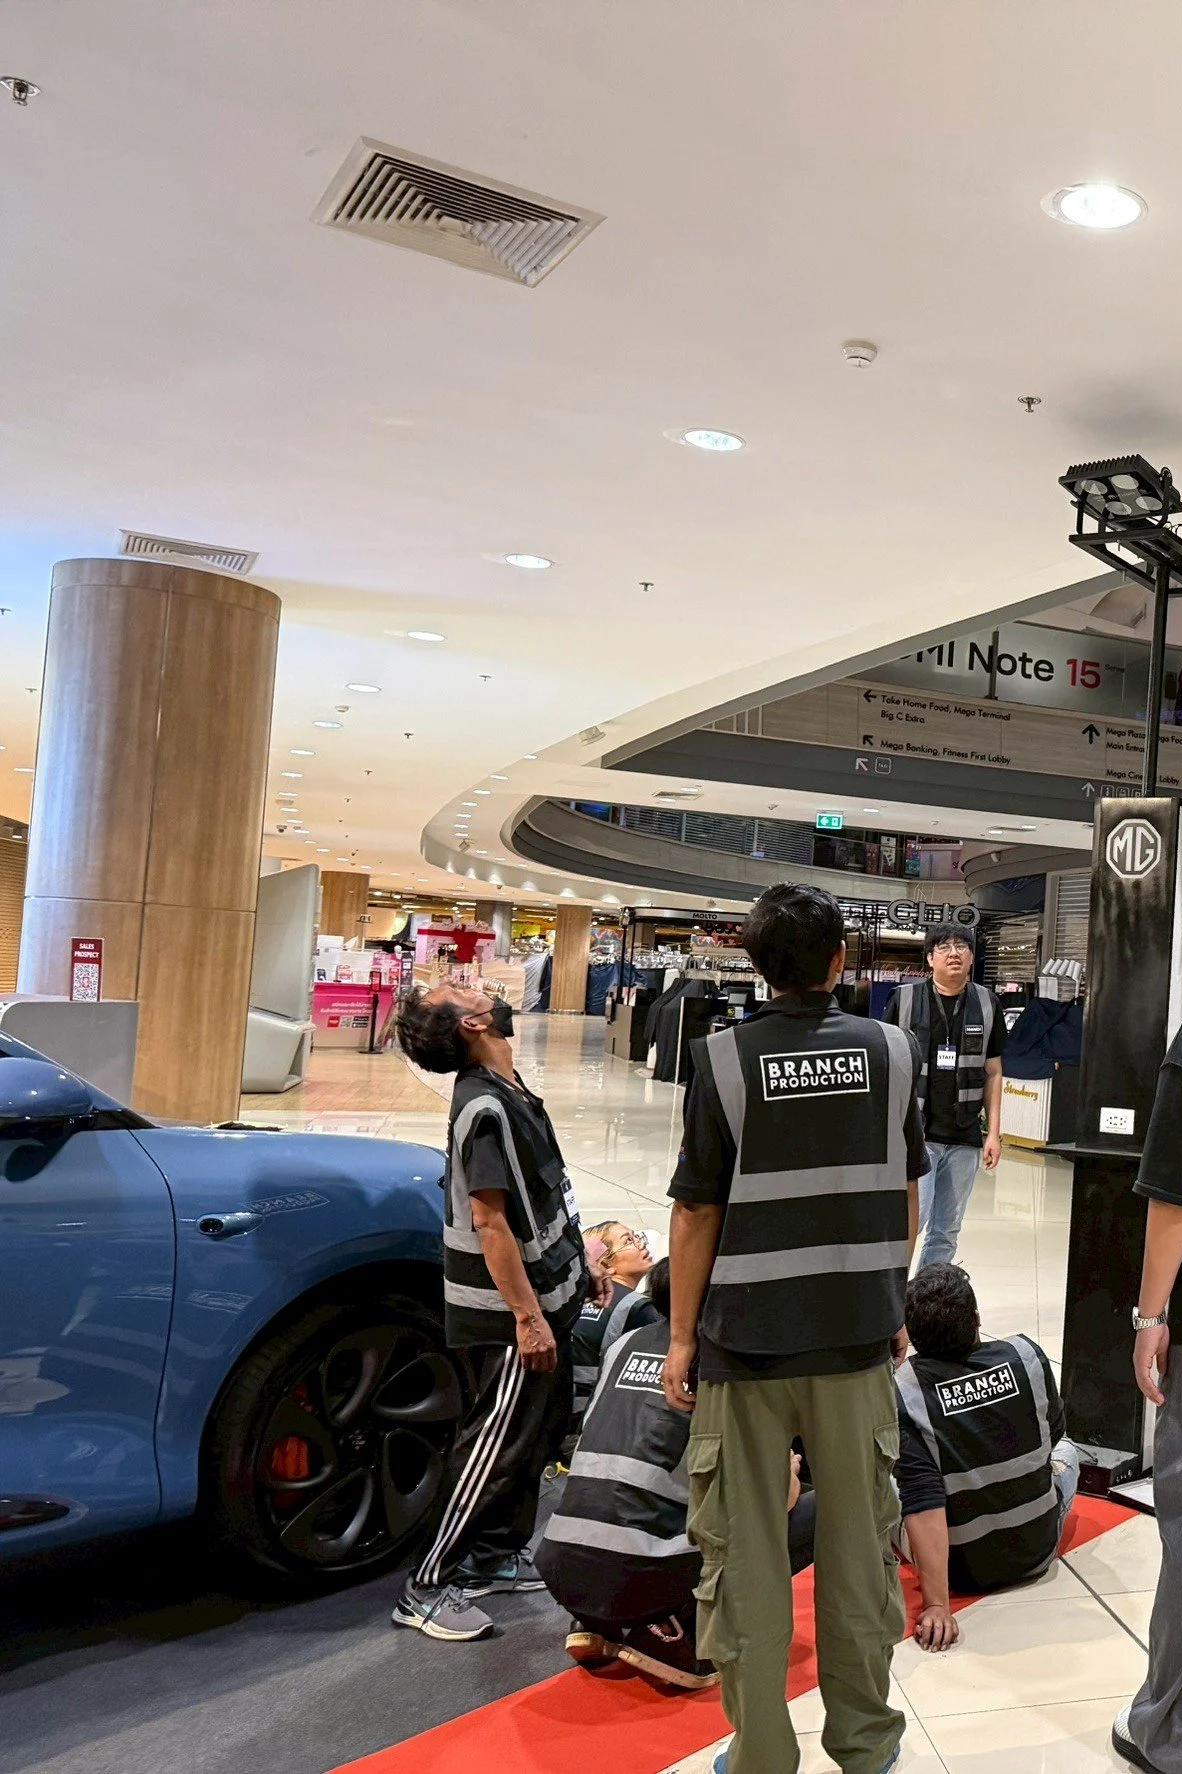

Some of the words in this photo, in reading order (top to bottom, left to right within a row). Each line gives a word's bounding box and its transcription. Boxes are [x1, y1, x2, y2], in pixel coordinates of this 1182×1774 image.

[968, 641, 1055, 683] Note
[1066, 657, 1102, 690] 15
[880, 709, 894, 721] Big
[896, 712, 903, 721] C
[905, 714, 925, 724] Extra
[881, 694, 901, 706] Take
[902, 699, 927, 710] Home
[929, 703, 952, 714] Food,
[954, 706, 976, 717] Mega
[978, 708, 1011, 721] Terminal
[1106, 727, 1126, 738] Mega
[880, 739, 904, 751] Mega
[906, 742, 940, 756] Banking,
[942, 747, 968, 760] Fitness
[971, 751, 986, 762] First
[988, 753, 1011, 765] Lobby
[1106, 741, 1124, 751] Main
[1106, 769, 1126, 780] Mega
[1160, 775, 1180, 786] Lobby
[1112, 826, 1155, 872] MG
[692, 912, 718, 920] MOLTO
[888, 899, 981, 929] CLIO
[74, 951, 100, 959] PROSPECT
[768, 1056, 863, 1079] BRANCH
[770, 1072, 864, 1095] PRODUCTION
[941, 1369, 1011, 1400] BRANCH
[944, 1380, 1013, 1408] PRODUCTION
